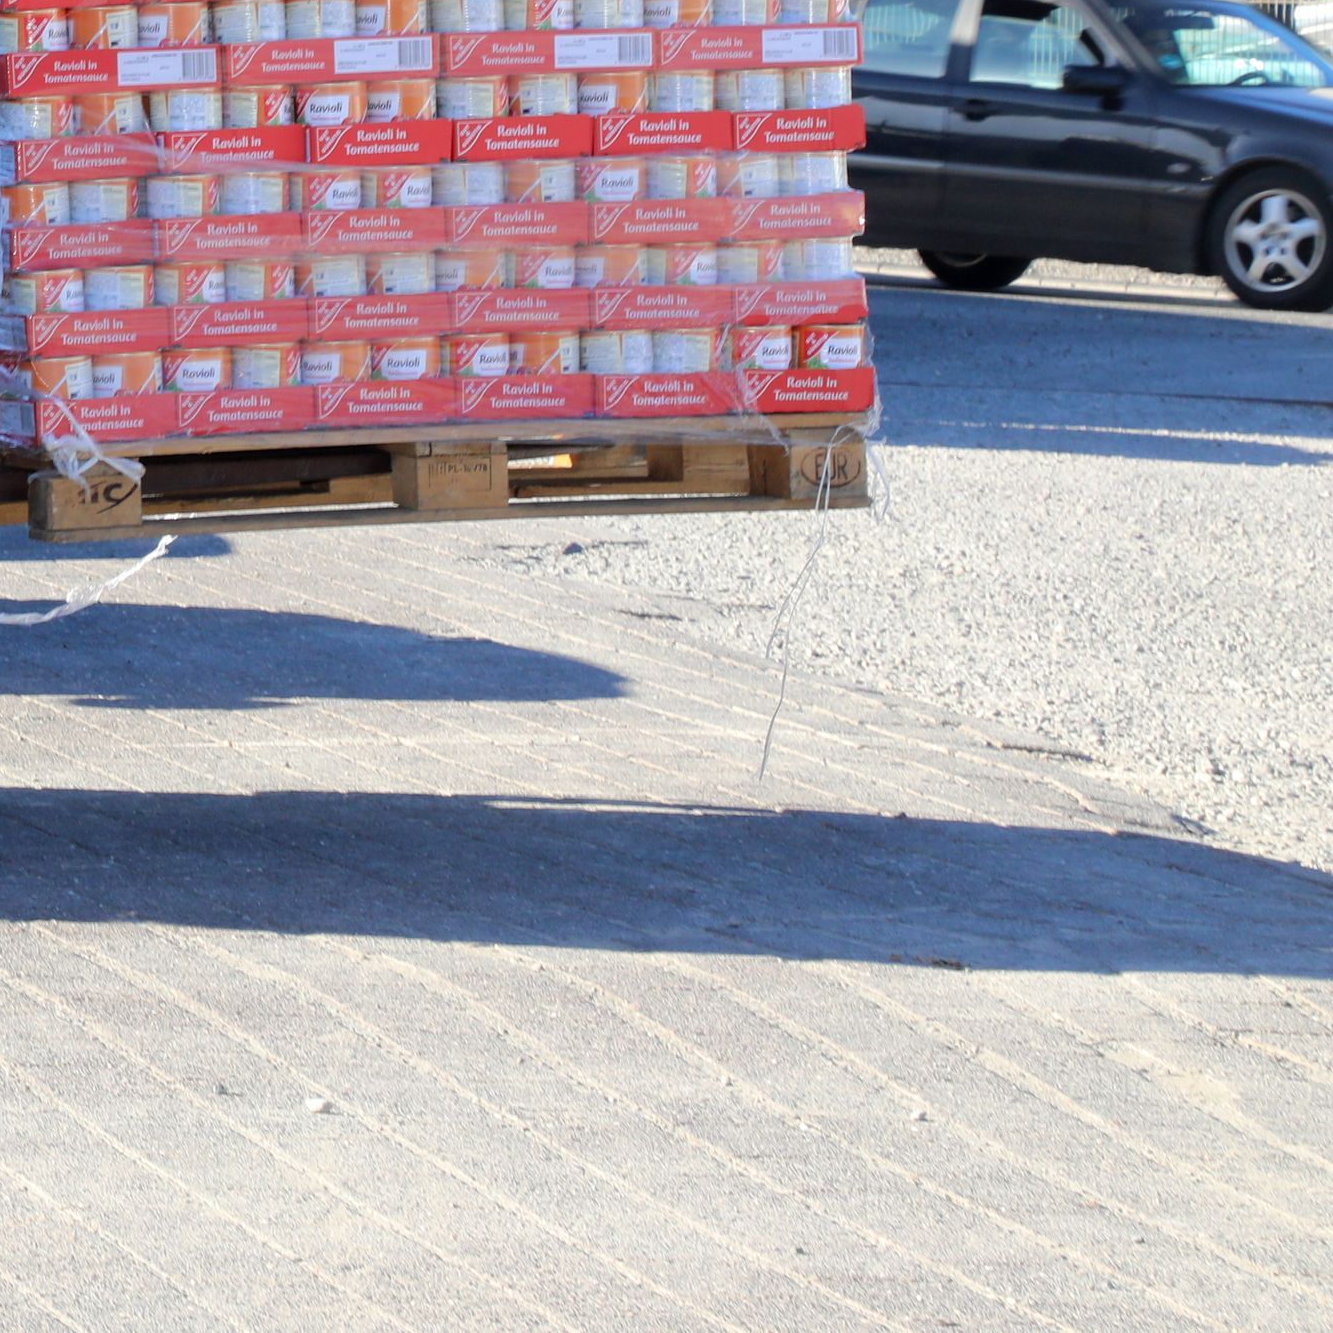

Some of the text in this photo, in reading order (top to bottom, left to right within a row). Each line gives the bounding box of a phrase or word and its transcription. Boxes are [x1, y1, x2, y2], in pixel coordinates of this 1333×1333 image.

[492, 42, 534, 54] Ravioli in
[701, 37, 743, 48] Ravioli in
[272, 48, 314, 60] Ravioli in
[54, 60, 97, 72] Ravioli in
[309, 102, 343, 114] Ravioli
[497, 123, 534, 137] Ravioli
[536, 123, 547, 136] in
[639, 118, 677, 132] Ravioli
[679, 118, 690, 131] in
[776, 116, 814, 130] Ravioli
[816, 116, 827, 129] in
[212, 135, 249, 149] Ravioli
[251, 135, 262, 148] in
[357, 128, 394, 142] Ravioli
[396, 128, 407, 141] in
[627, 132, 704, 146] Tomatensauce
[64, 142, 101, 156] Ravioli
[103, 142, 114, 155] in
[345, 142, 420, 156] Tomatensauce
[485, 137, 560, 151] Tomatensauce
[52, 156, 127, 170] Tomatensauce
[494, 209, 531, 223] Ravioli
[534, 209, 544, 222] in
[635, 206, 673, 220] Ravioli
[676, 206, 686, 219] in
[770, 202, 808, 216] Ravioli
[810, 202, 821, 215] in
[349, 214, 387, 228] Ravioli
[390, 214, 400, 227] in
[622, 220, 699, 234] Tomatensauce
[207, 221, 245, 236] Ravioli
[248, 221, 258, 234] in
[336, 228, 415, 243] Tomatensauce
[481, 223, 558, 237] Tomatensauce
[99, 231, 109, 243] in
[195, 235, 272, 249] Tomatensauce
[496, 295, 546, 309] Ravioli in
[636, 292, 687, 306] Ravioli in
[776, 289, 826, 303] Ravioli in
[214, 308, 251, 322] Ravioli
[253, 308, 264, 321] in
[356, 301, 394, 316] Ravioli
[397, 301, 407, 314] in
[624, 306, 701, 320] Tomatensauce
[343, 315, 420, 329] Tomatensauce
[483, 309, 560, 323] Tomatensauce
[74, 318, 110, 332] Ravioli
[113, 318, 123, 330] in
[202, 322, 277, 336] Tomatensauce
[61, 331, 138, 345] Tomatensauce
[387, 358, 420, 368] Ravioli
[183, 368, 215, 379] Ravioli
[502, 381, 553, 396] Ravioli in
[644, 379, 694, 393] Ravioli in
[786, 375, 837, 390] Ravioli in
[360, 386, 410, 400] Ravioli in
[773, 389, 850, 403] Tomatensauce
[220, 394, 270, 408] Ravioli in
[347, 400, 424, 414] Tomatensauce
[490, 395, 566, 409] Tomatensauce
[80, 404, 131, 418] Ravioli in
[208, 408, 284, 422] Tomatensauce
